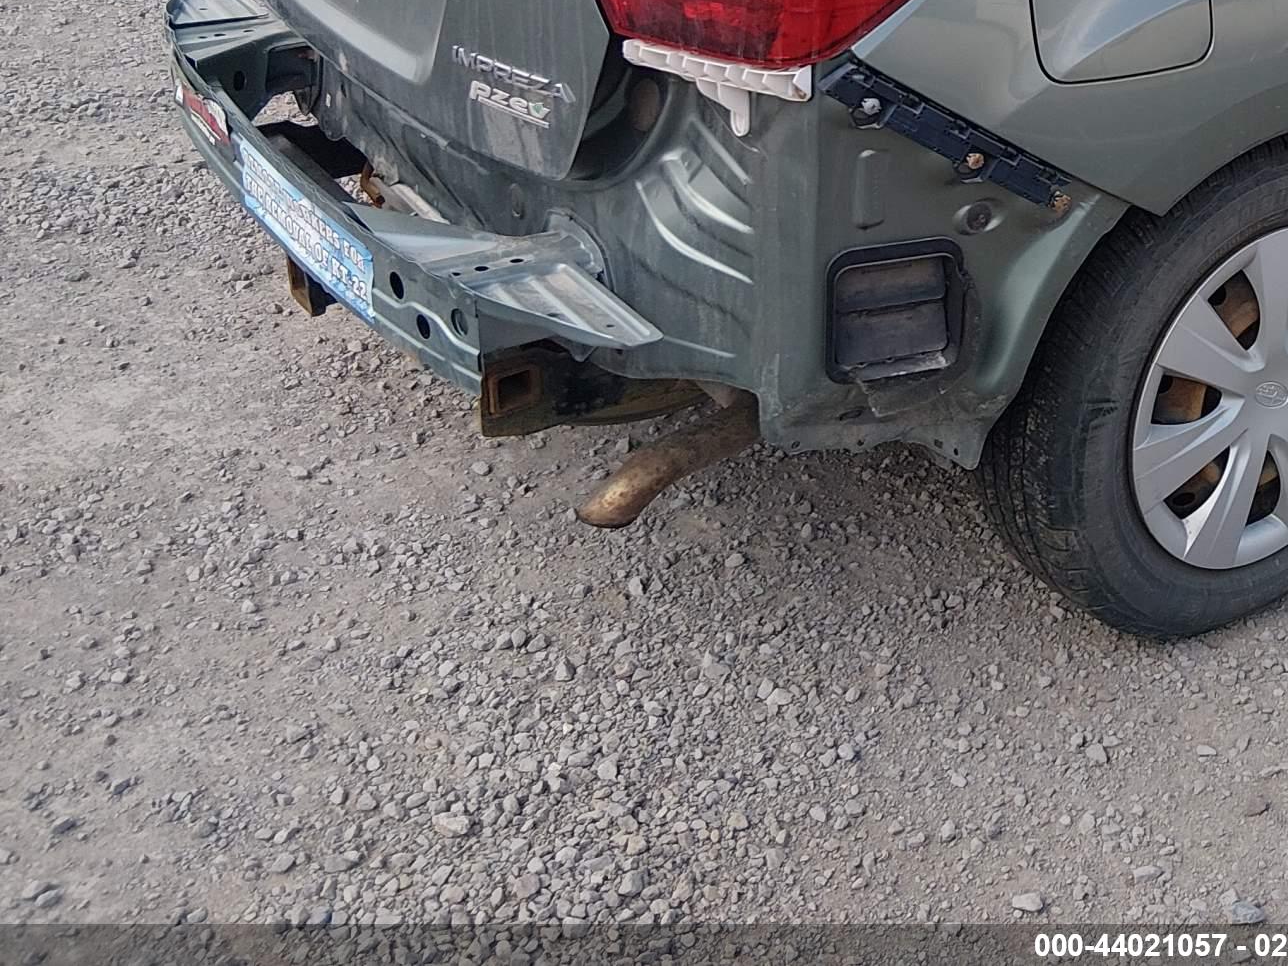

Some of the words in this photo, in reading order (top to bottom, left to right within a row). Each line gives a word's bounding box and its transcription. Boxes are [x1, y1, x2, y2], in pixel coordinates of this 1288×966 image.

[452, 45, 576, 103] IMPREZA
[265, 192, 312, 254] REMOVAL
[314, 242, 330, 269] OF
[343, 239, 366, 273] FOR
